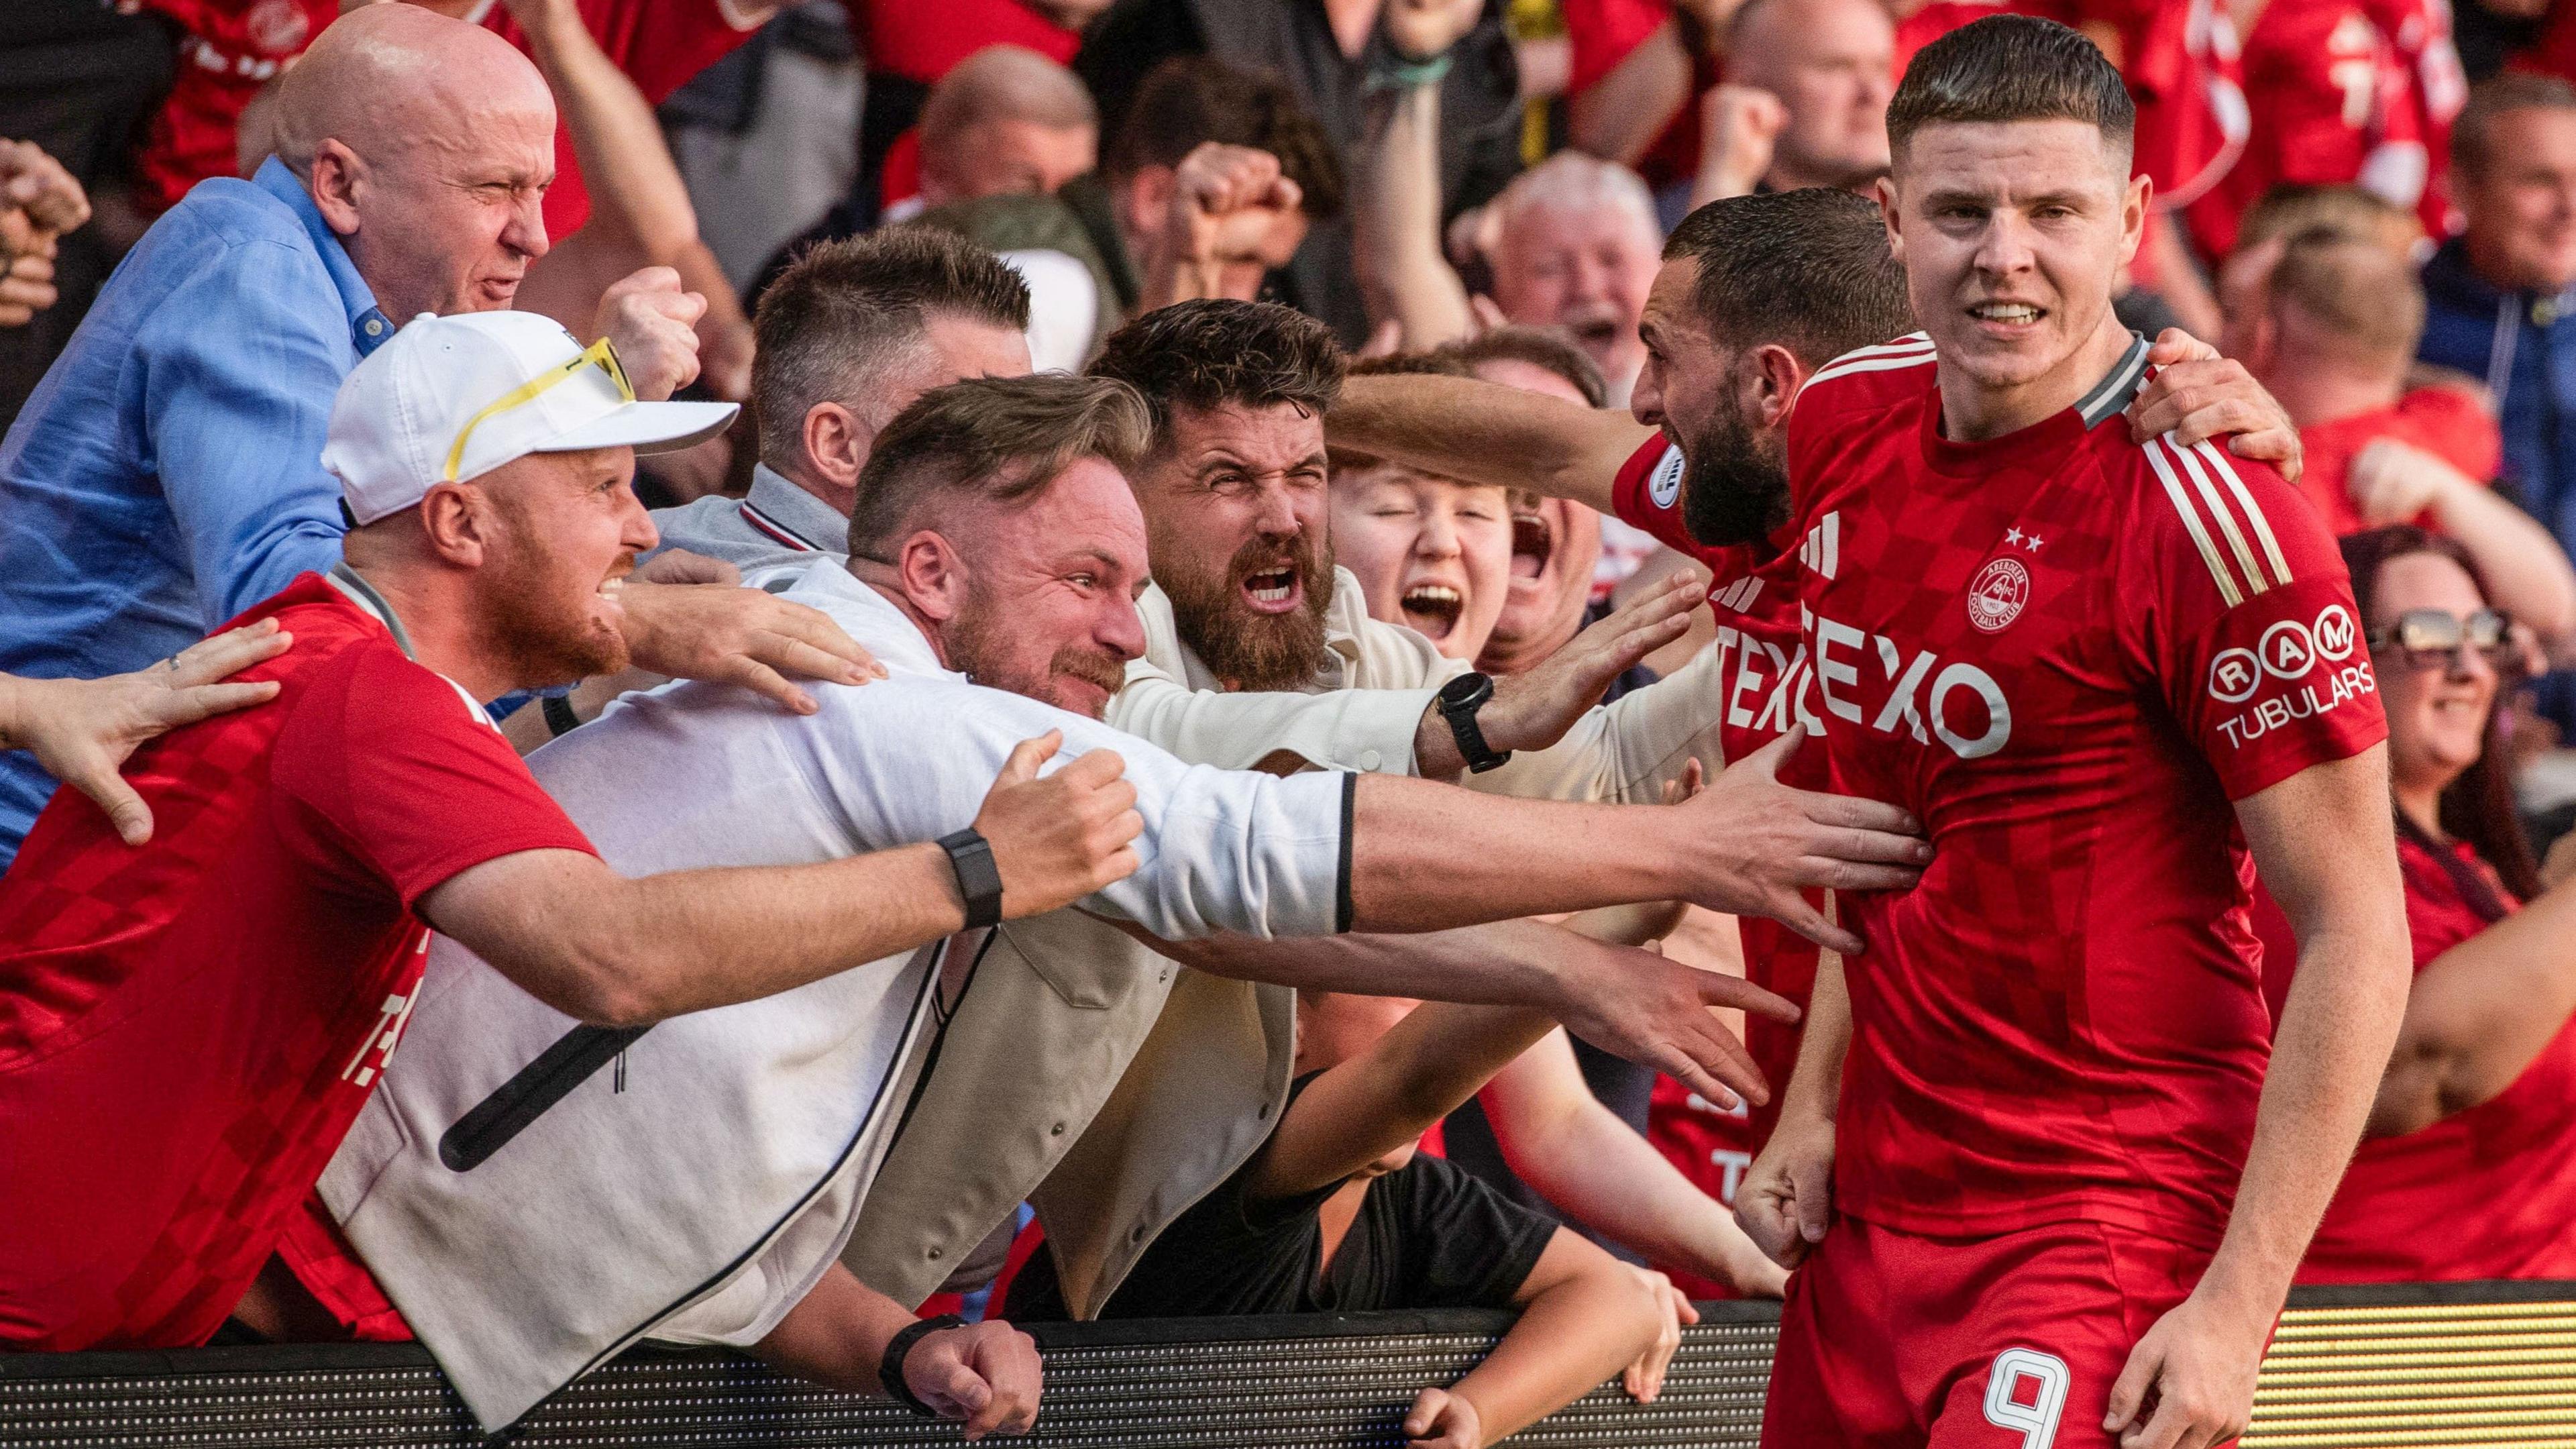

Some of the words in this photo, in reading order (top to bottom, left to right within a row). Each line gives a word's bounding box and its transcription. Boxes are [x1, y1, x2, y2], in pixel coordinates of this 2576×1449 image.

[1970, 591, 1998, 627] FOOTBALL
[1999, 601, 2021, 624] CLUB
[1988, 561, 2025, 584] ABERDEEN
[1802, 598, 2012, 759] EXO
[2216, 662, 2375, 749] TUBULARS
[1983, 1347, 2071, 1449] 9
